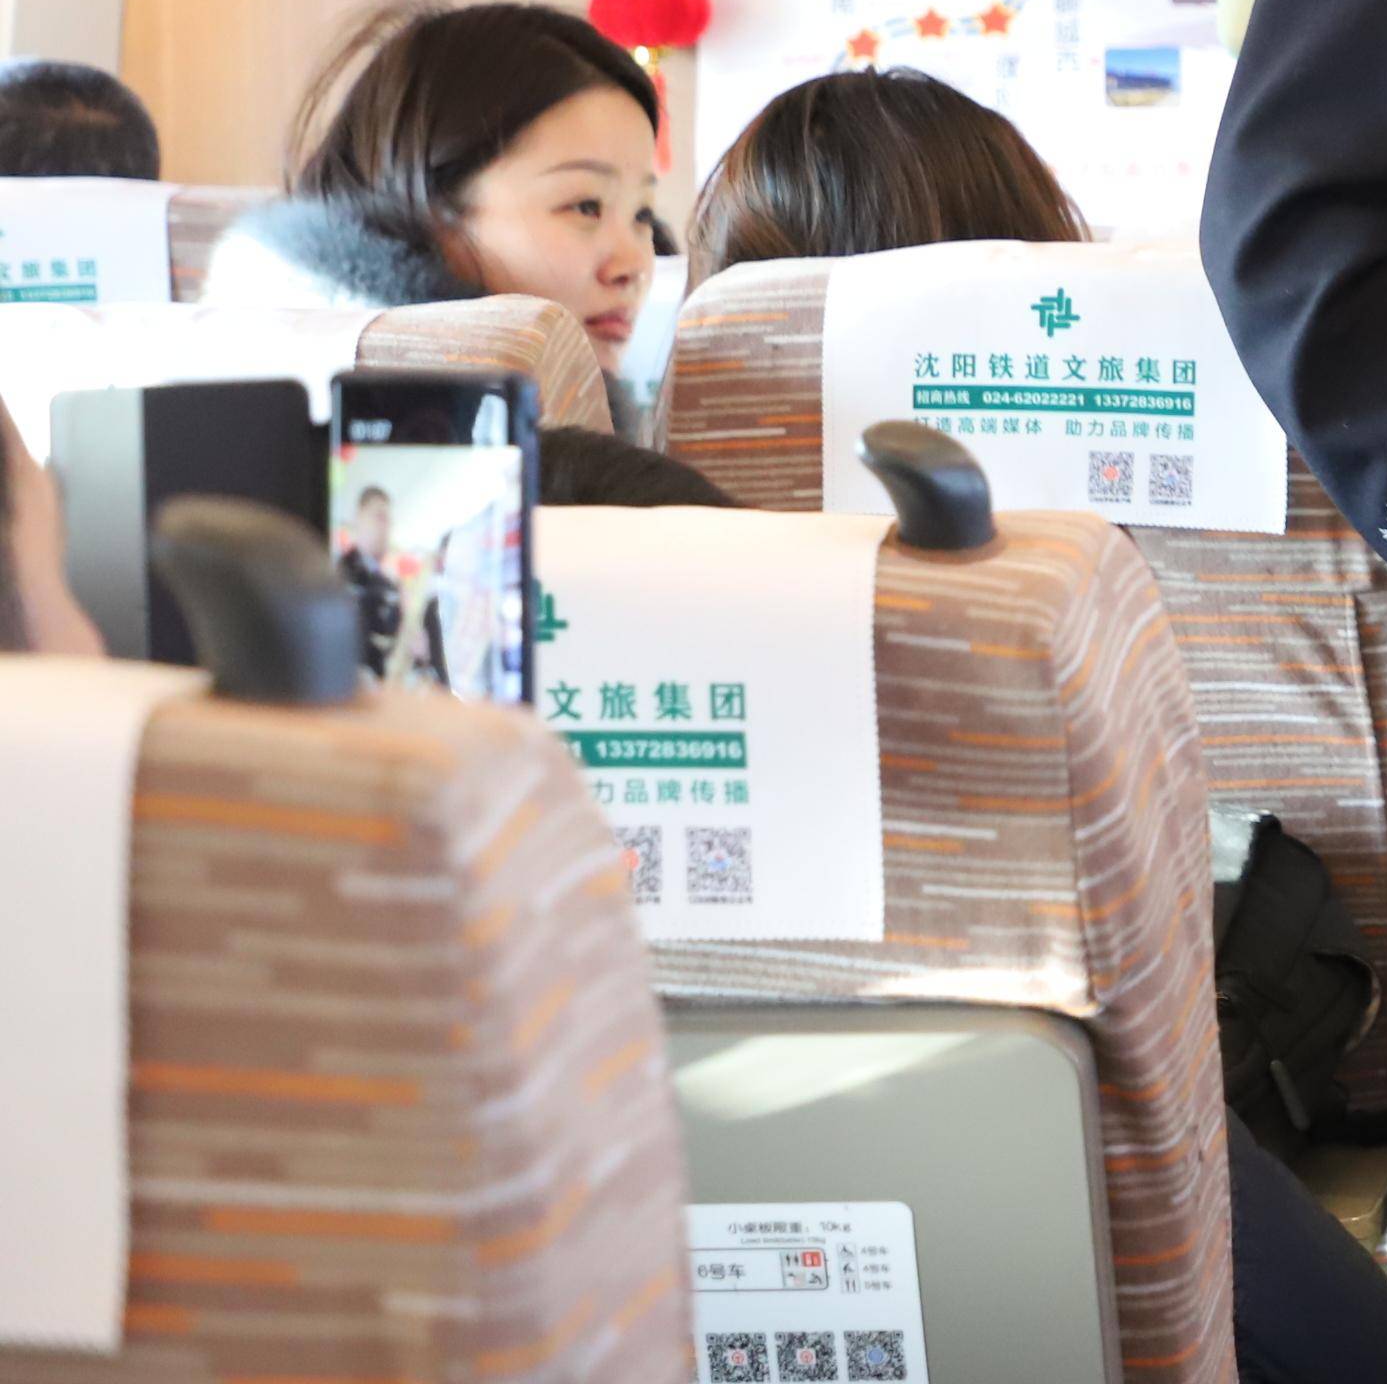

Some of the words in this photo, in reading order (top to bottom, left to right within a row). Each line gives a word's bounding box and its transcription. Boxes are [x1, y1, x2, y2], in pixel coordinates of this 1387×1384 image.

[914, 353, 1197, 385] 沈阳铁道文旅集团
[917, 389, 970, 406] 招商热线
[982, 390, 1086, 407] 024-62022221
[1094, 394, 1192, 411] 13372836916
[1064, 419, 1195, 441] 助力品牌传播
[546, 681, 746, 721] 文旅集团
